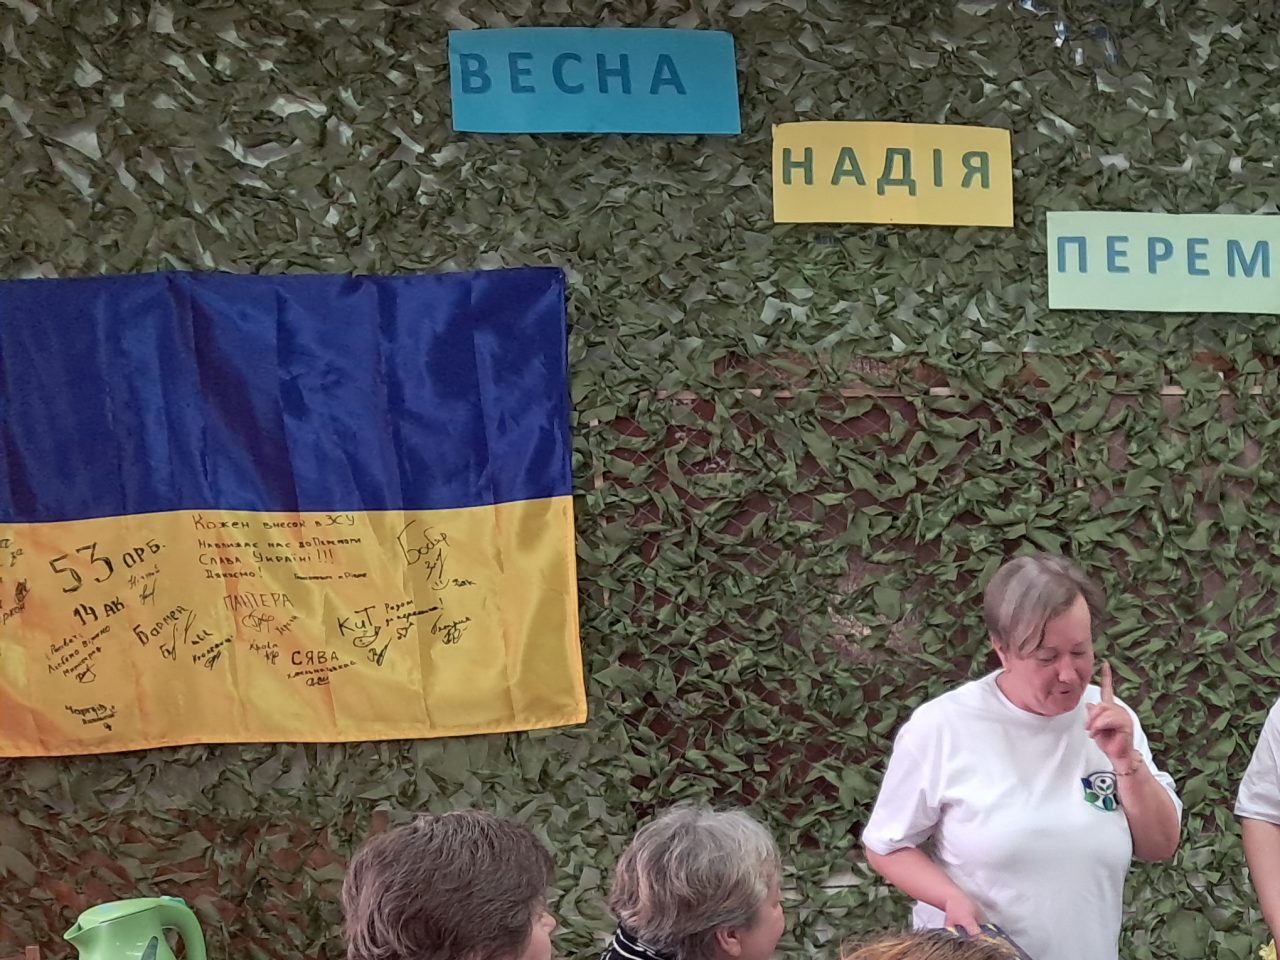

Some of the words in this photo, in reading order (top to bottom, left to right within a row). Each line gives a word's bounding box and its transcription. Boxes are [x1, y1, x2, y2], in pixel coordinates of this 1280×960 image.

[460, 51, 687, 95] ВЕСНА
[782, 146, 992, 196] НАДІЯ
[192, 513, 250, 531] Кожен
[263, 519, 306, 530] внесок
[49, 541, 115, 594] 53
[73, 602, 99, 626] 14
[103, 596, 126, 618] АК
[223, 591, 295, 612] ПАНТЕРА
[291, 650, 340, 666] СЯВА
